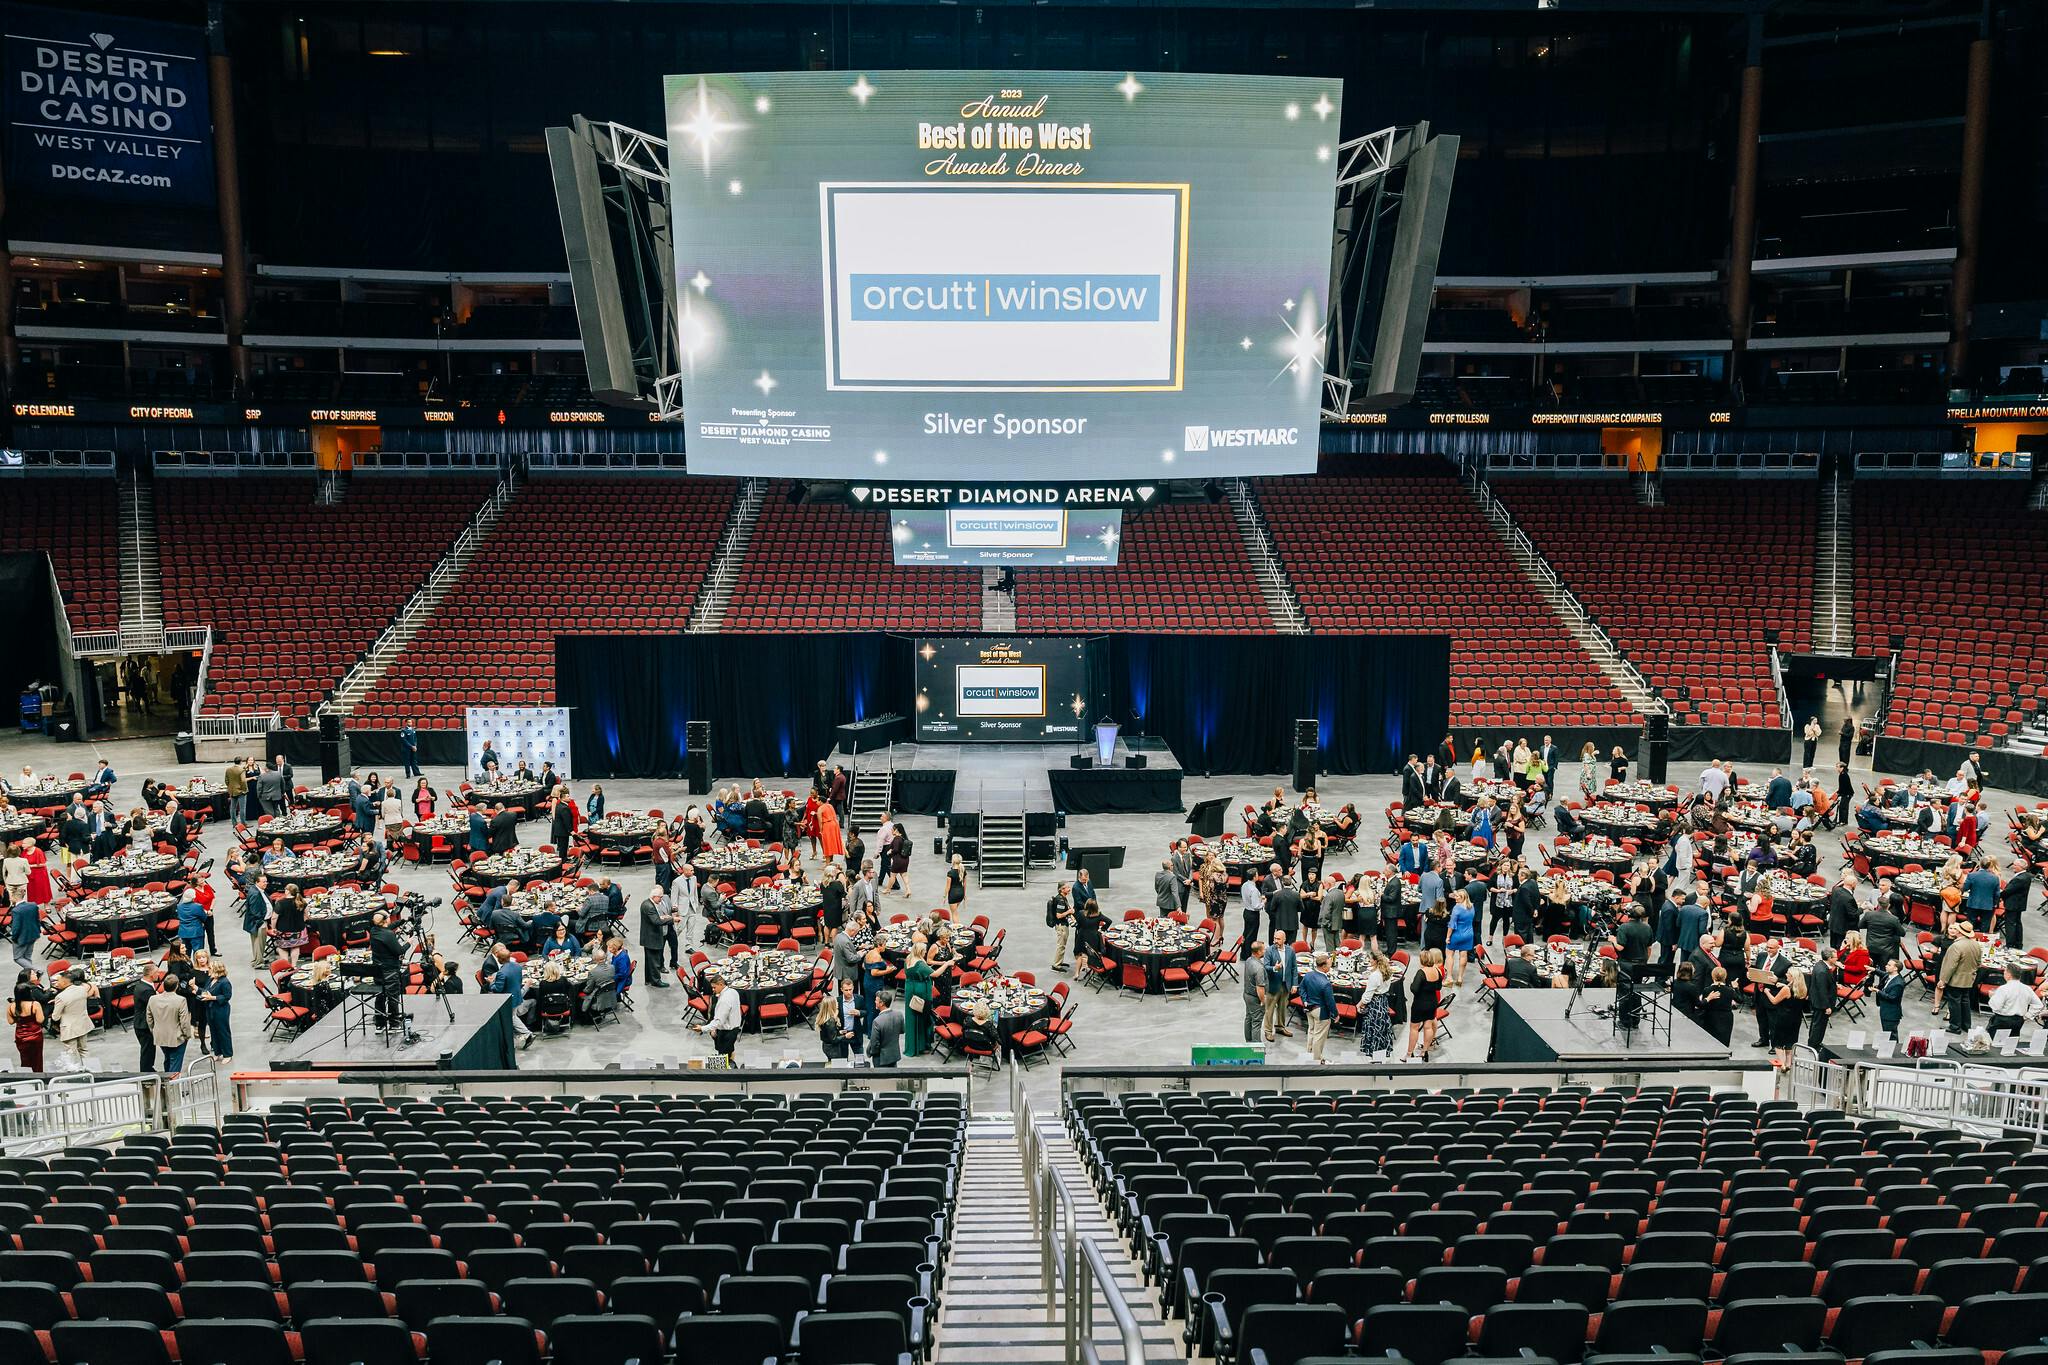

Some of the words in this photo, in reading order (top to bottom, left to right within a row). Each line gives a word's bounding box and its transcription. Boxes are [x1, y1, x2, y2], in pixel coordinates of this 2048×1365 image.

[37, 47, 168, 81] DESERT
[21, 71, 187, 107] DIAMOND
[1001, 89, 1023, 98] 2023
[960, 95, 1048, 118] Annual
[40, 99, 172, 131] CASINO
[919, 122, 966, 149] Best
[971, 122, 993, 149] of
[998, 122, 1033, 149] the
[1038, 122, 1092, 150] West
[35, 133, 95, 150] WEST
[104, 140, 182, 159] VALLEY
[924, 152, 1010, 176] Awards
[1015, 152, 1085, 177] Dinner
[52, 164, 171, 187] DDCAZ.com
[15, 405, 28, 416] OF
[30, 405, 75, 416] GLENDALE
[130, 407, 149, 418] CITY
[151, 407, 162, 418] OF
[163, 407, 193, 419] PEORIA
[245, 409, 261, 419] SRP
[311, 410, 329, 420] CITY
[330, 410, 340, 420] OF
[341, 410, 376, 421] SURPRISE
[424, 411, 454, 421] VERIZON
[731, 407, 766, 418] Presenting
[767, 408, 796, 419] Sponsor
[1982, 407, 2028, 418] MOUNTAIN
[551, 412, 569, 421] GOLD
[571, 412, 605, 422] SPONSOR:
[1351, 413, 1387, 424] GOODYEAR
[1430, 413, 1445, 424] CITY
[1446, 413, 1455, 424] OF
[1456, 413, 1490, 424] TOLLESON
[1532, 414, 1578, 424] COPPERPOINT
[1579, 413, 1620, 424] INSURANCE
[1620, 413, 1662, 423] COMPANIES
[1710, 412, 1730, 423] CORE
[923, 412, 987, 435] Silver
[993, 413, 1088, 439] Sponsor
[700, 426, 738, 436] DESERT
[740, 427, 788, 437] DIAMOND
[791, 428, 831, 438] CASINO
[1210, 427, 1299, 447] WESTMARC
[739, 436, 761, 445] WEST
[762, 437, 791, 445] VALLEY
[873, 488, 952, 503] DESERT
[959, 488, 1059, 503] DIAMOND
[1065, 487, 1135, 503] ARENA
[1002, 551, 1034, 559] Sponsor
[980, 721, 996, 729] Silver
[997, 722, 1022, 730] Sponsor
